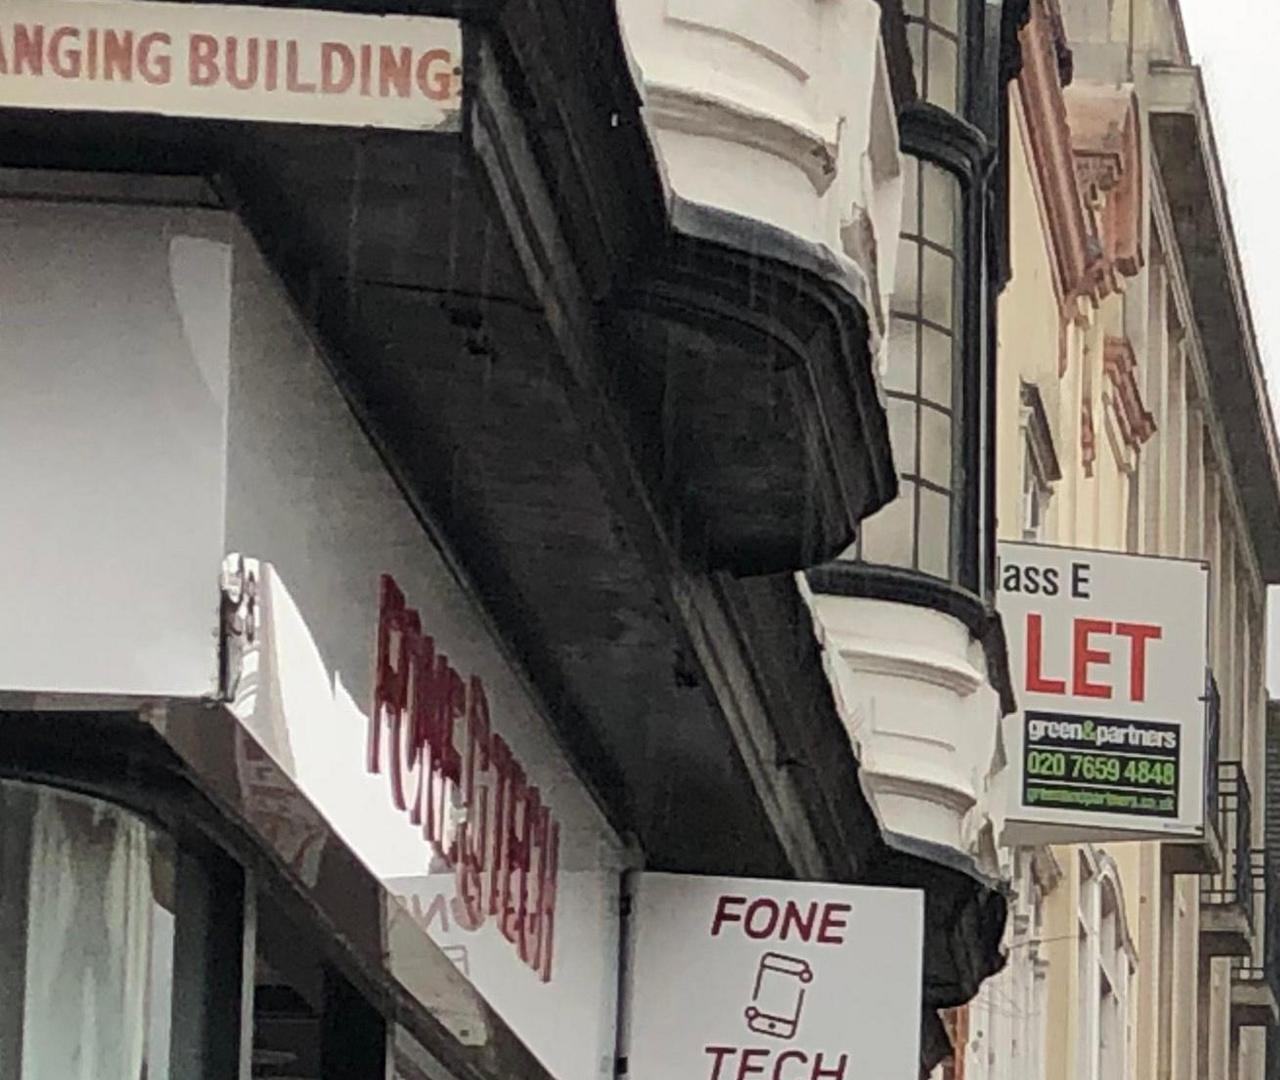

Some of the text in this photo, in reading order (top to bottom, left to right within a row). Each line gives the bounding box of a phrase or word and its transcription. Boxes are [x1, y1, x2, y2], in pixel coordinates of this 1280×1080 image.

[0, 22, 452, 101] NGING BUILDING
[1072, 562, 1091, 600] E
[1025, 613, 1162, 703] LET
[1028, 720, 1177, 749] green&partners
[1027, 751, 1175, 786] 020 7659 4848
[711, 896, 852, 945] FONE
